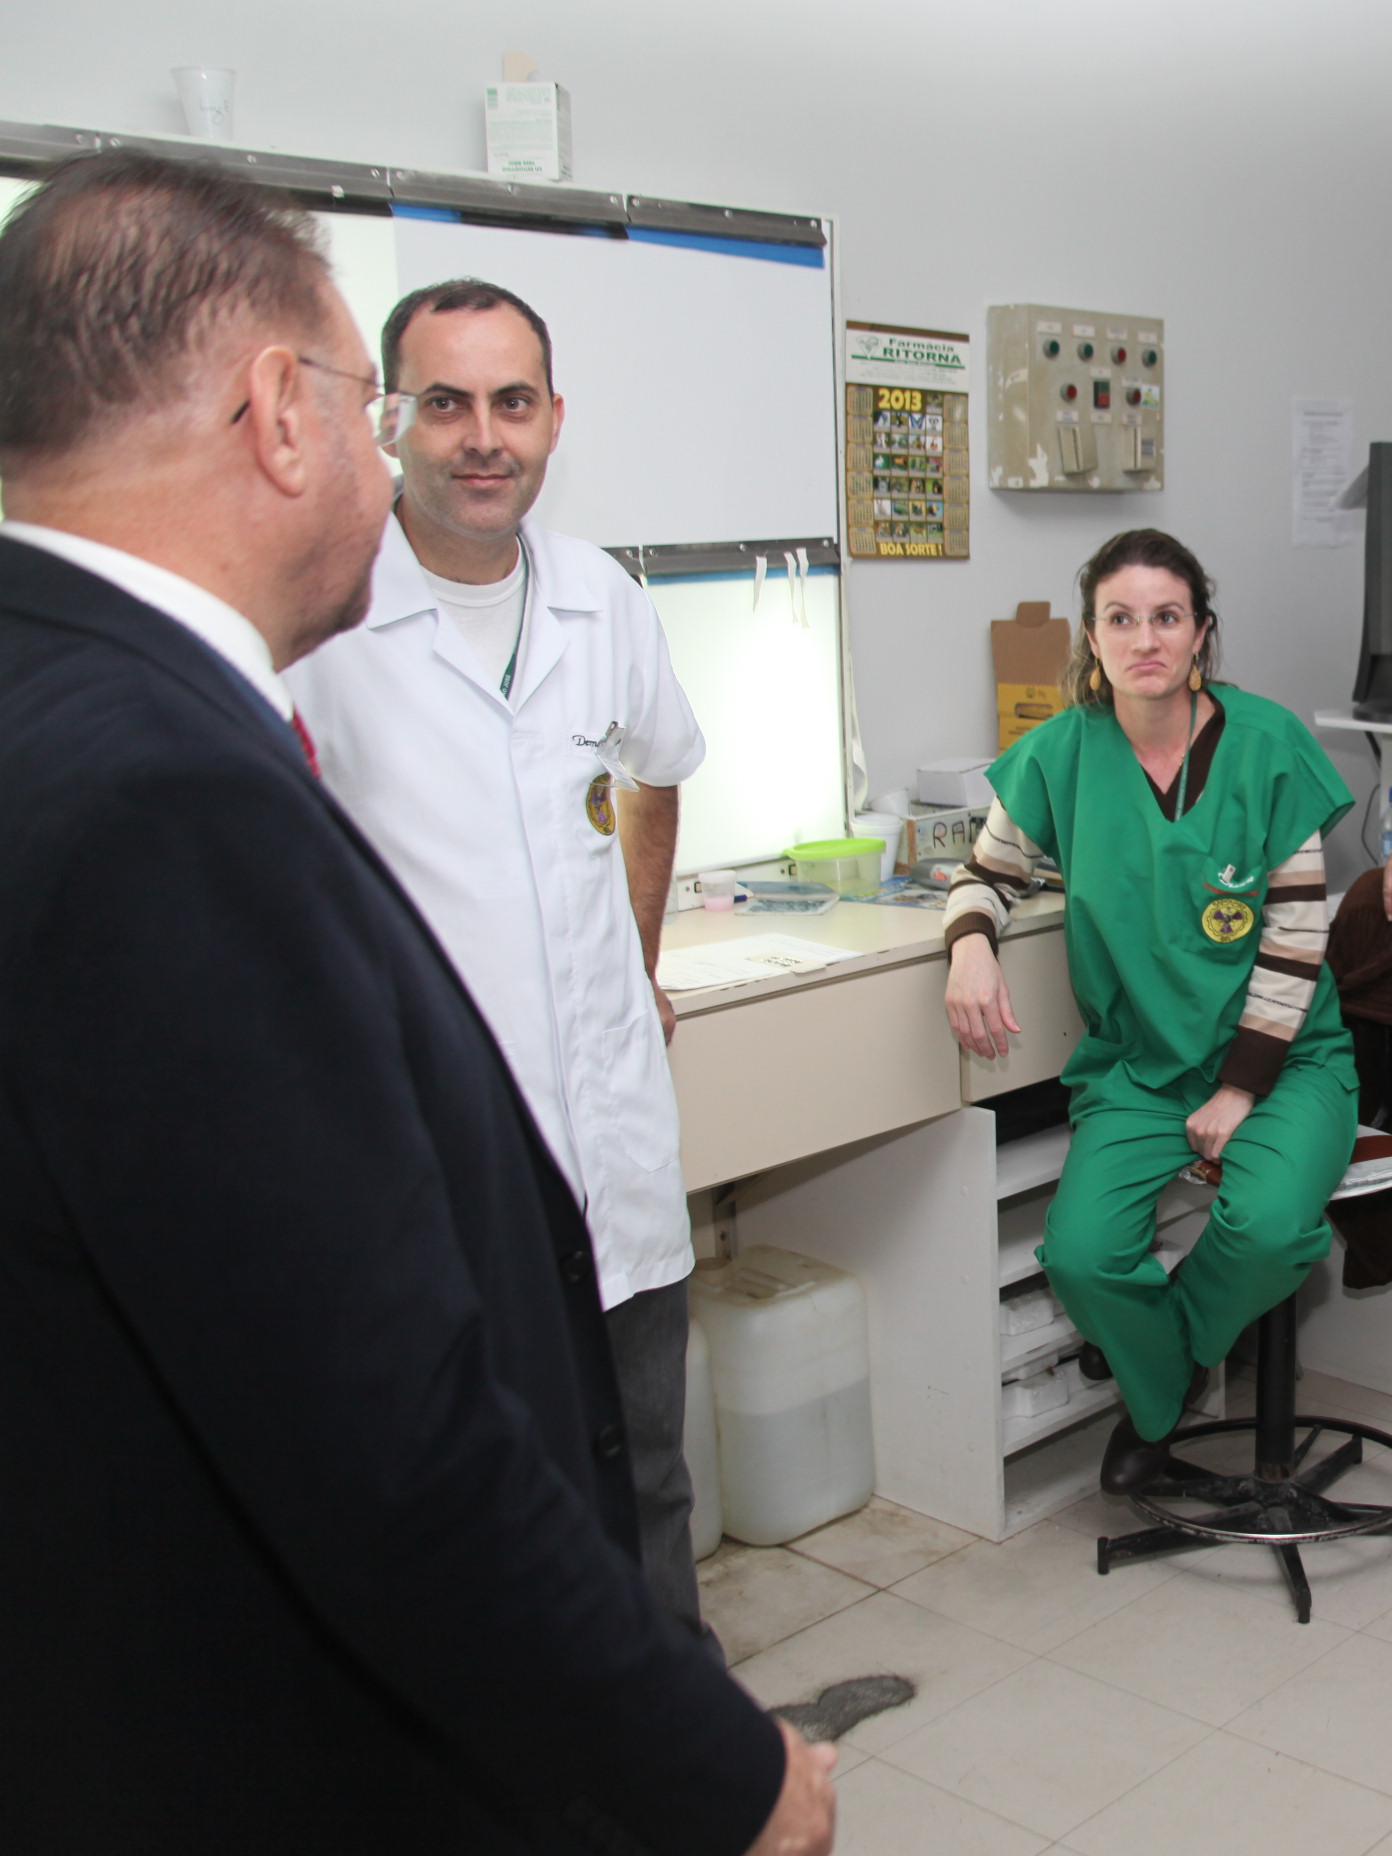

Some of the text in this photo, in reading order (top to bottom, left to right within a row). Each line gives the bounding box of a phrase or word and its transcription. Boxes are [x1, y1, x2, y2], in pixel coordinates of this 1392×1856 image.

[883, 347, 962, 364] RITORNA
[878, 387, 922, 411] 2013
[880, 542, 904, 556] BOA
[905, 542, 937, 556] SORTE
